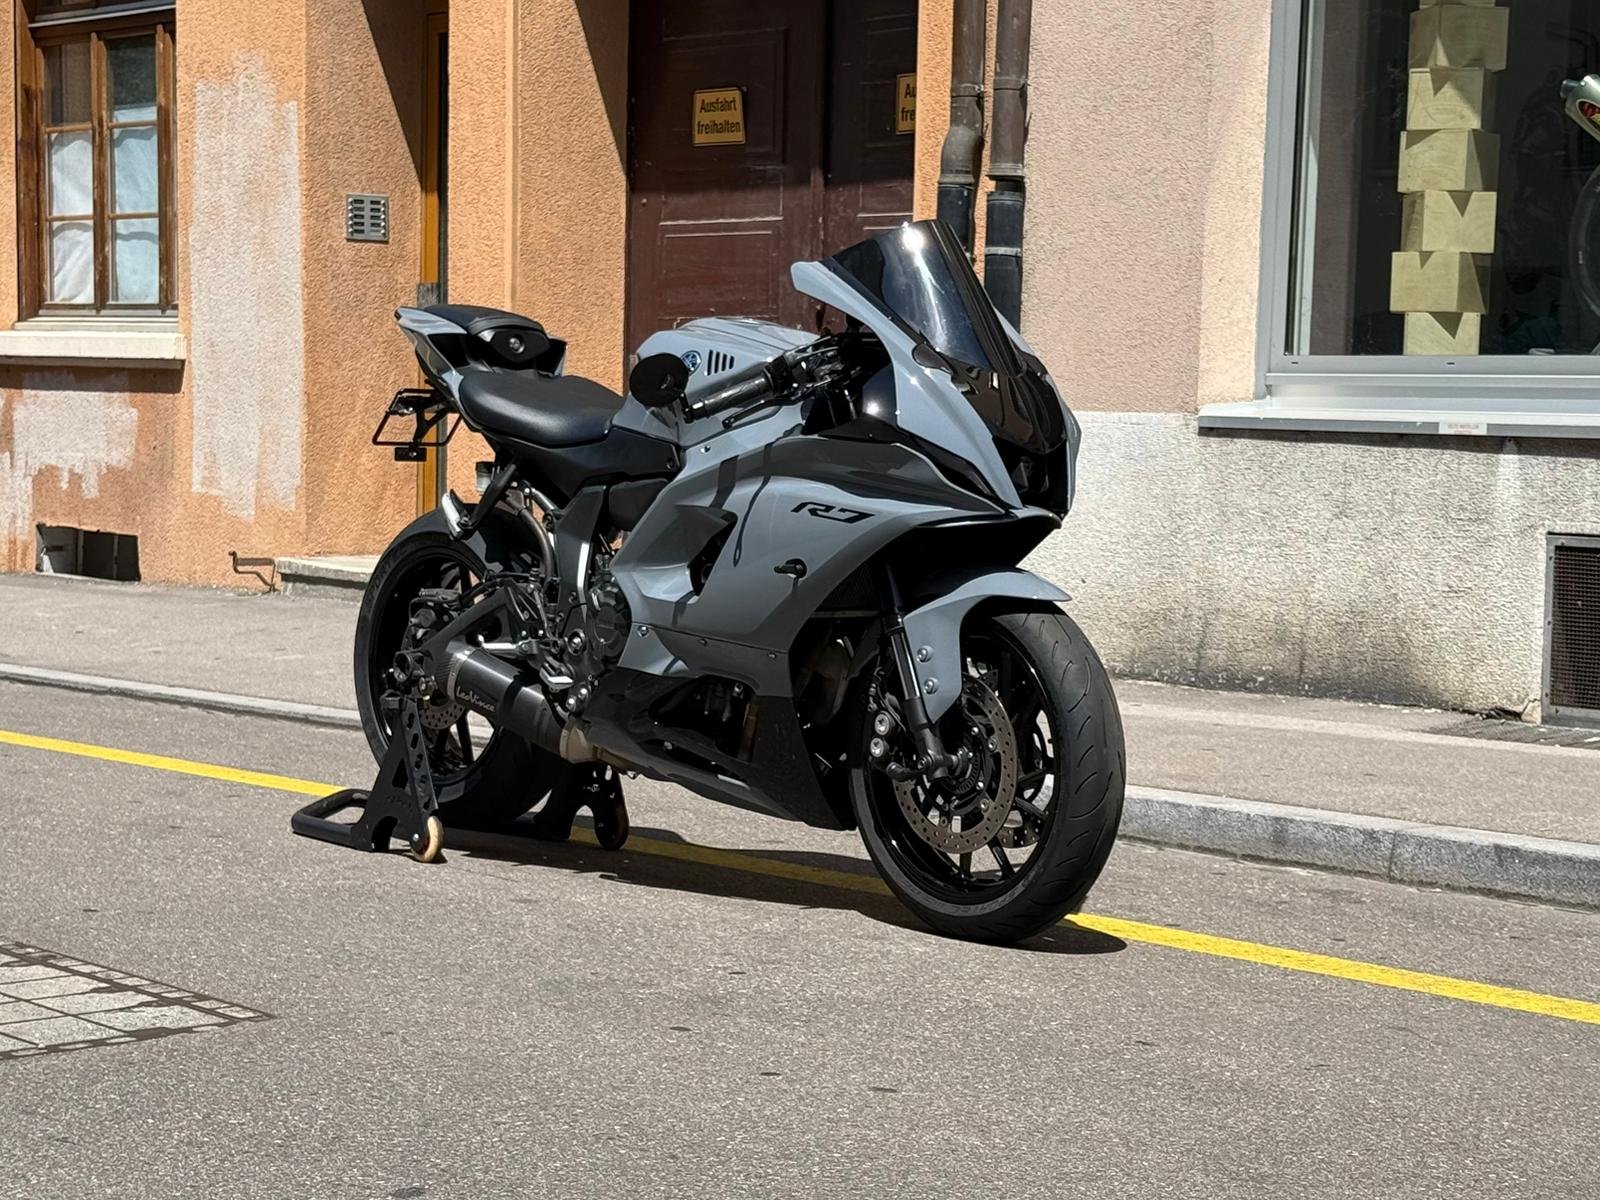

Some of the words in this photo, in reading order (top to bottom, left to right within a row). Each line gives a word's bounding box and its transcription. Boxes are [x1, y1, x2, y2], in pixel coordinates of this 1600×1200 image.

[699, 97, 737, 113] Ausfahrt
[697, 120, 741, 135] freihalten
[790, 502, 876, 524] R7
